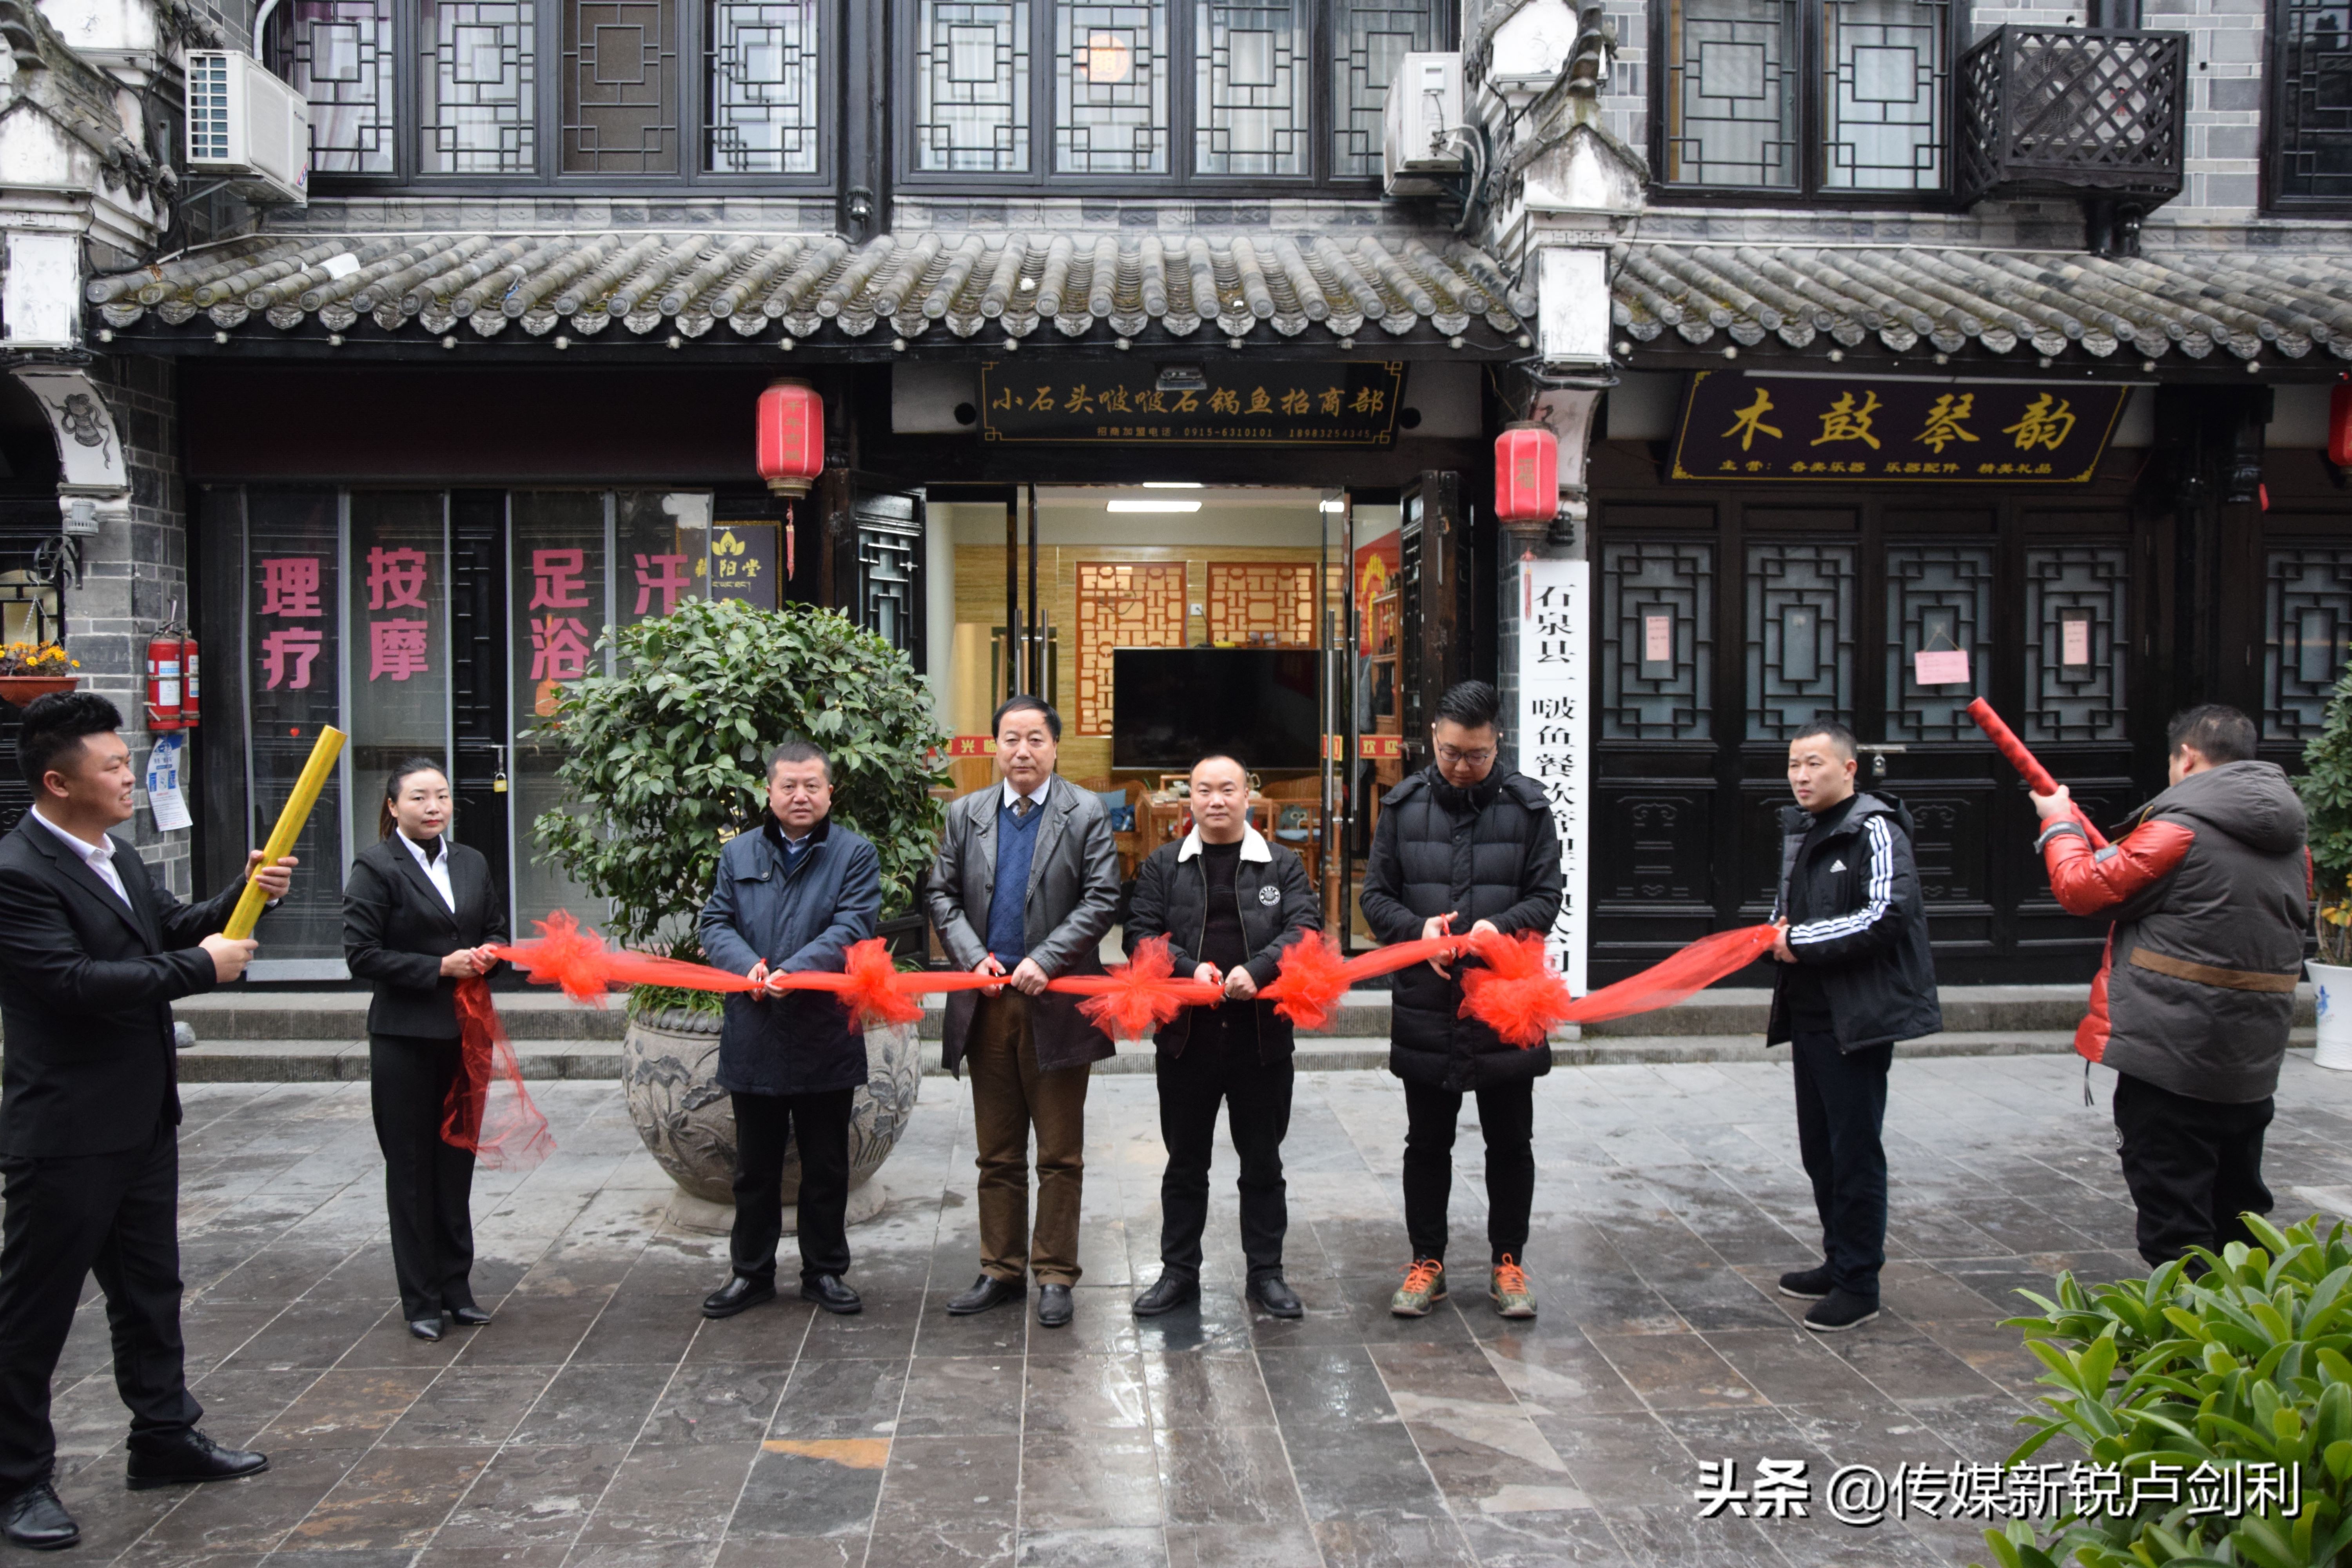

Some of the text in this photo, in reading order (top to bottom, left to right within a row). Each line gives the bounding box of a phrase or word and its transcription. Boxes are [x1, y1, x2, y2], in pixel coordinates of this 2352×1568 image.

[992, 383, 1385, 417] 小石头啵啵石锅鱼招商部
[1720, 388, 2076, 454] 木鼓琴韵
[1184, 427, 1272, 437] 0915-6310101
[1883, 461, 1960, 474] 乐器配件
[367, 546, 428, 682] 按摩
[530, 549, 590, 680] 足浴
[634, 554, 690, 615] 汗
[262, 557, 323, 690] 理疗
